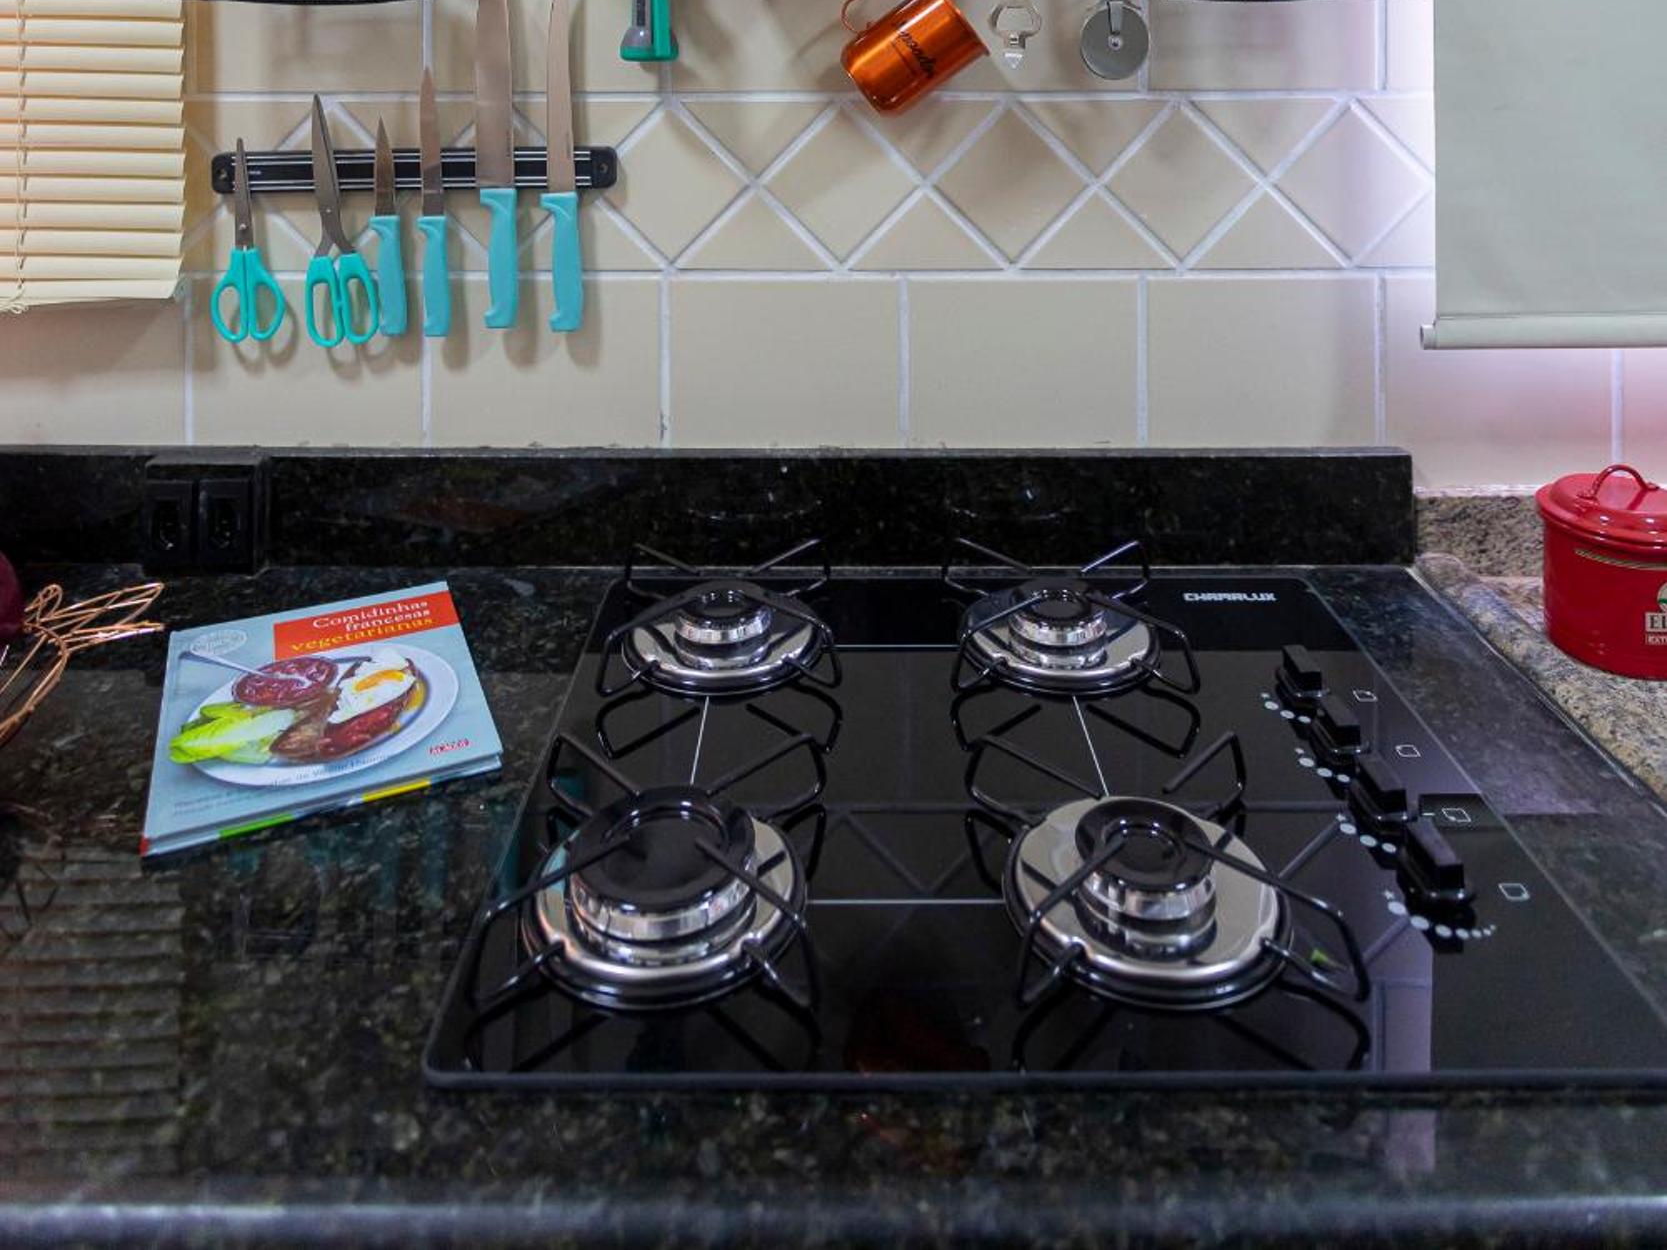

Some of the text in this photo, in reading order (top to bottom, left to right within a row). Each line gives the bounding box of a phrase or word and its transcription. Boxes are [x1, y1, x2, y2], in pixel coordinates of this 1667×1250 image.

[312, 600, 428, 629] Comidinhas
[344, 609, 431, 631] francesas
[291, 618, 433, 652] vegetarianas
